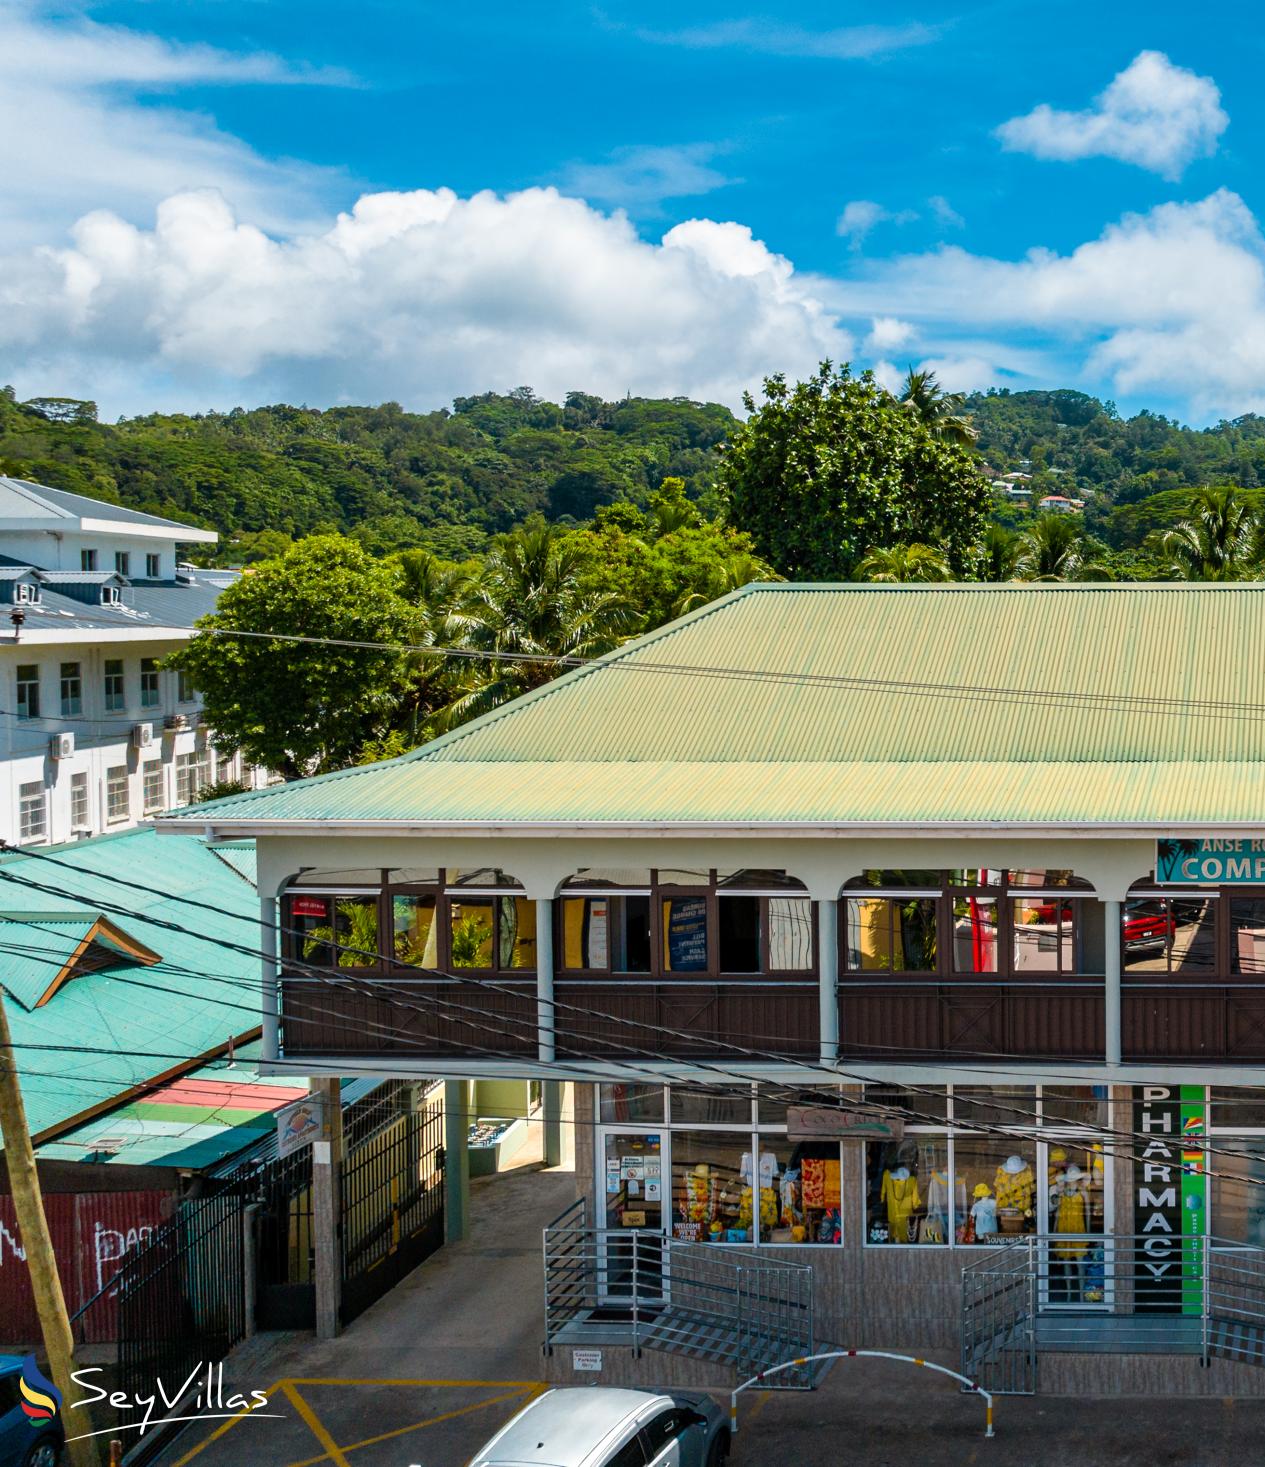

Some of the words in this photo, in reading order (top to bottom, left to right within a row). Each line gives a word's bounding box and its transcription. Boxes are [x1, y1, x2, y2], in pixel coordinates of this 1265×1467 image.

[1202, 839, 1243, 852] ANSE
[1139, 1086, 1176, 1282] PHARMACY
[674, 1222, 701, 1230] WELCOME
